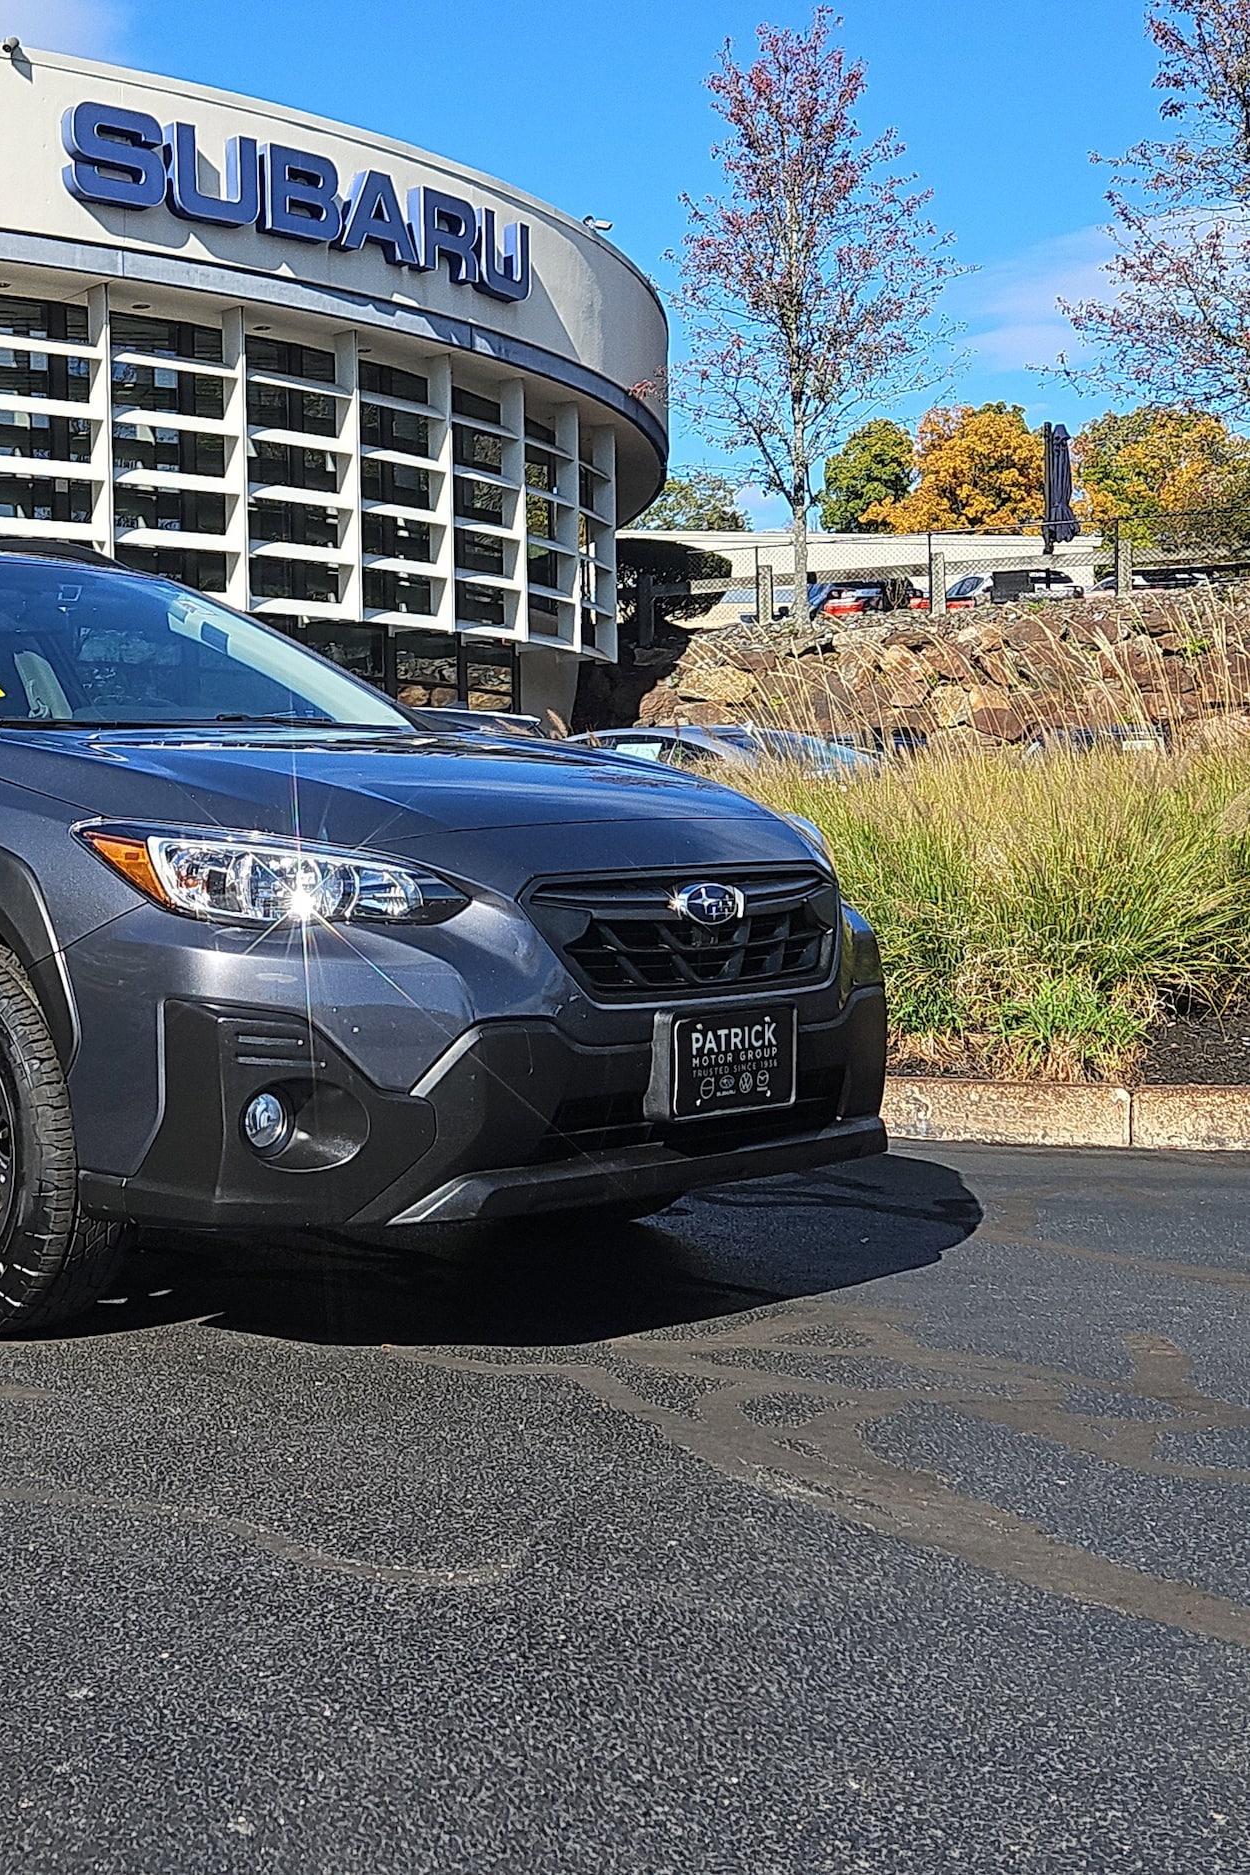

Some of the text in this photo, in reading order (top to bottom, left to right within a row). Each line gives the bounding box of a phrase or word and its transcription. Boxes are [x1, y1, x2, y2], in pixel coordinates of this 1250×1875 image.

[61, 101, 532, 303] SUBARU
[691, 1022, 778, 1056] PATRICK
[692, 1046, 778, 1068] MOTOR GROUP
[692, 1065, 730, 1078] TRUSTED
[733, 1061, 757, 1073] SINCE
